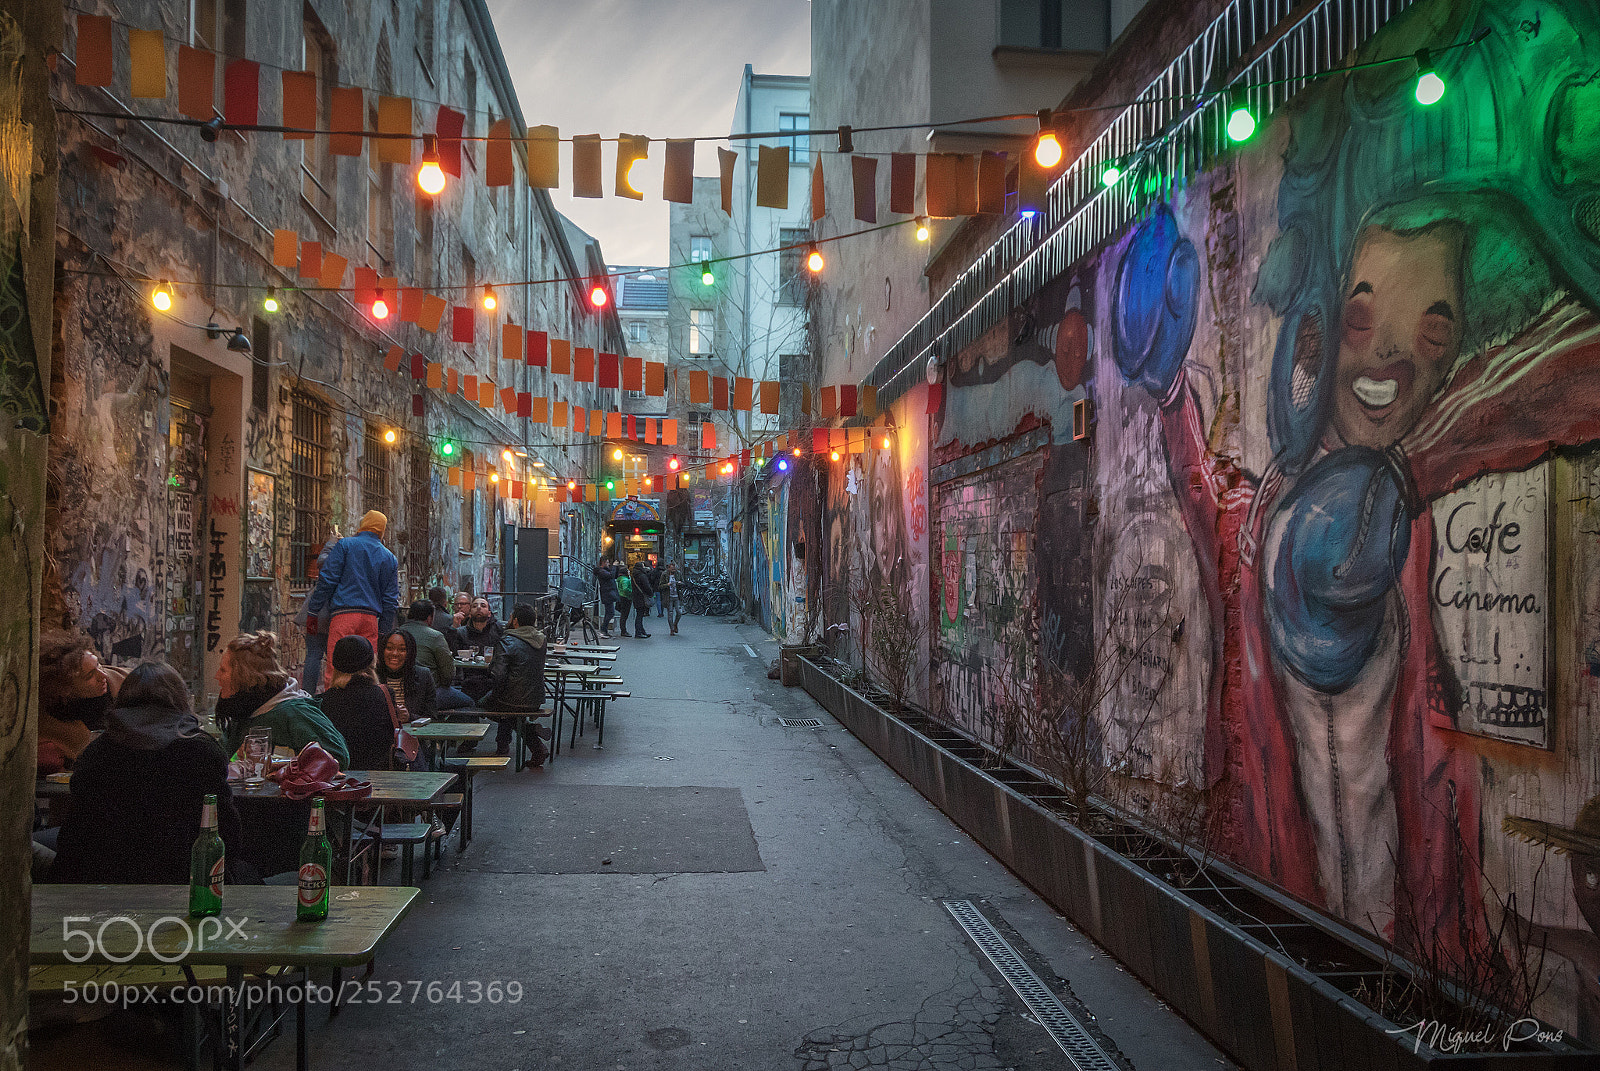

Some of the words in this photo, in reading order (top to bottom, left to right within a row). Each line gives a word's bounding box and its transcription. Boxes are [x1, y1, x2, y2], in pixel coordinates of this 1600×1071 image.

[177, 512, 191, 530] WAS
[176, 532, 192, 550] HERE
[1446, 502, 1521, 562] Cafe
[1435, 566, 1541, 614] Cinema
[299, 880, 326, 888] BECK'S
